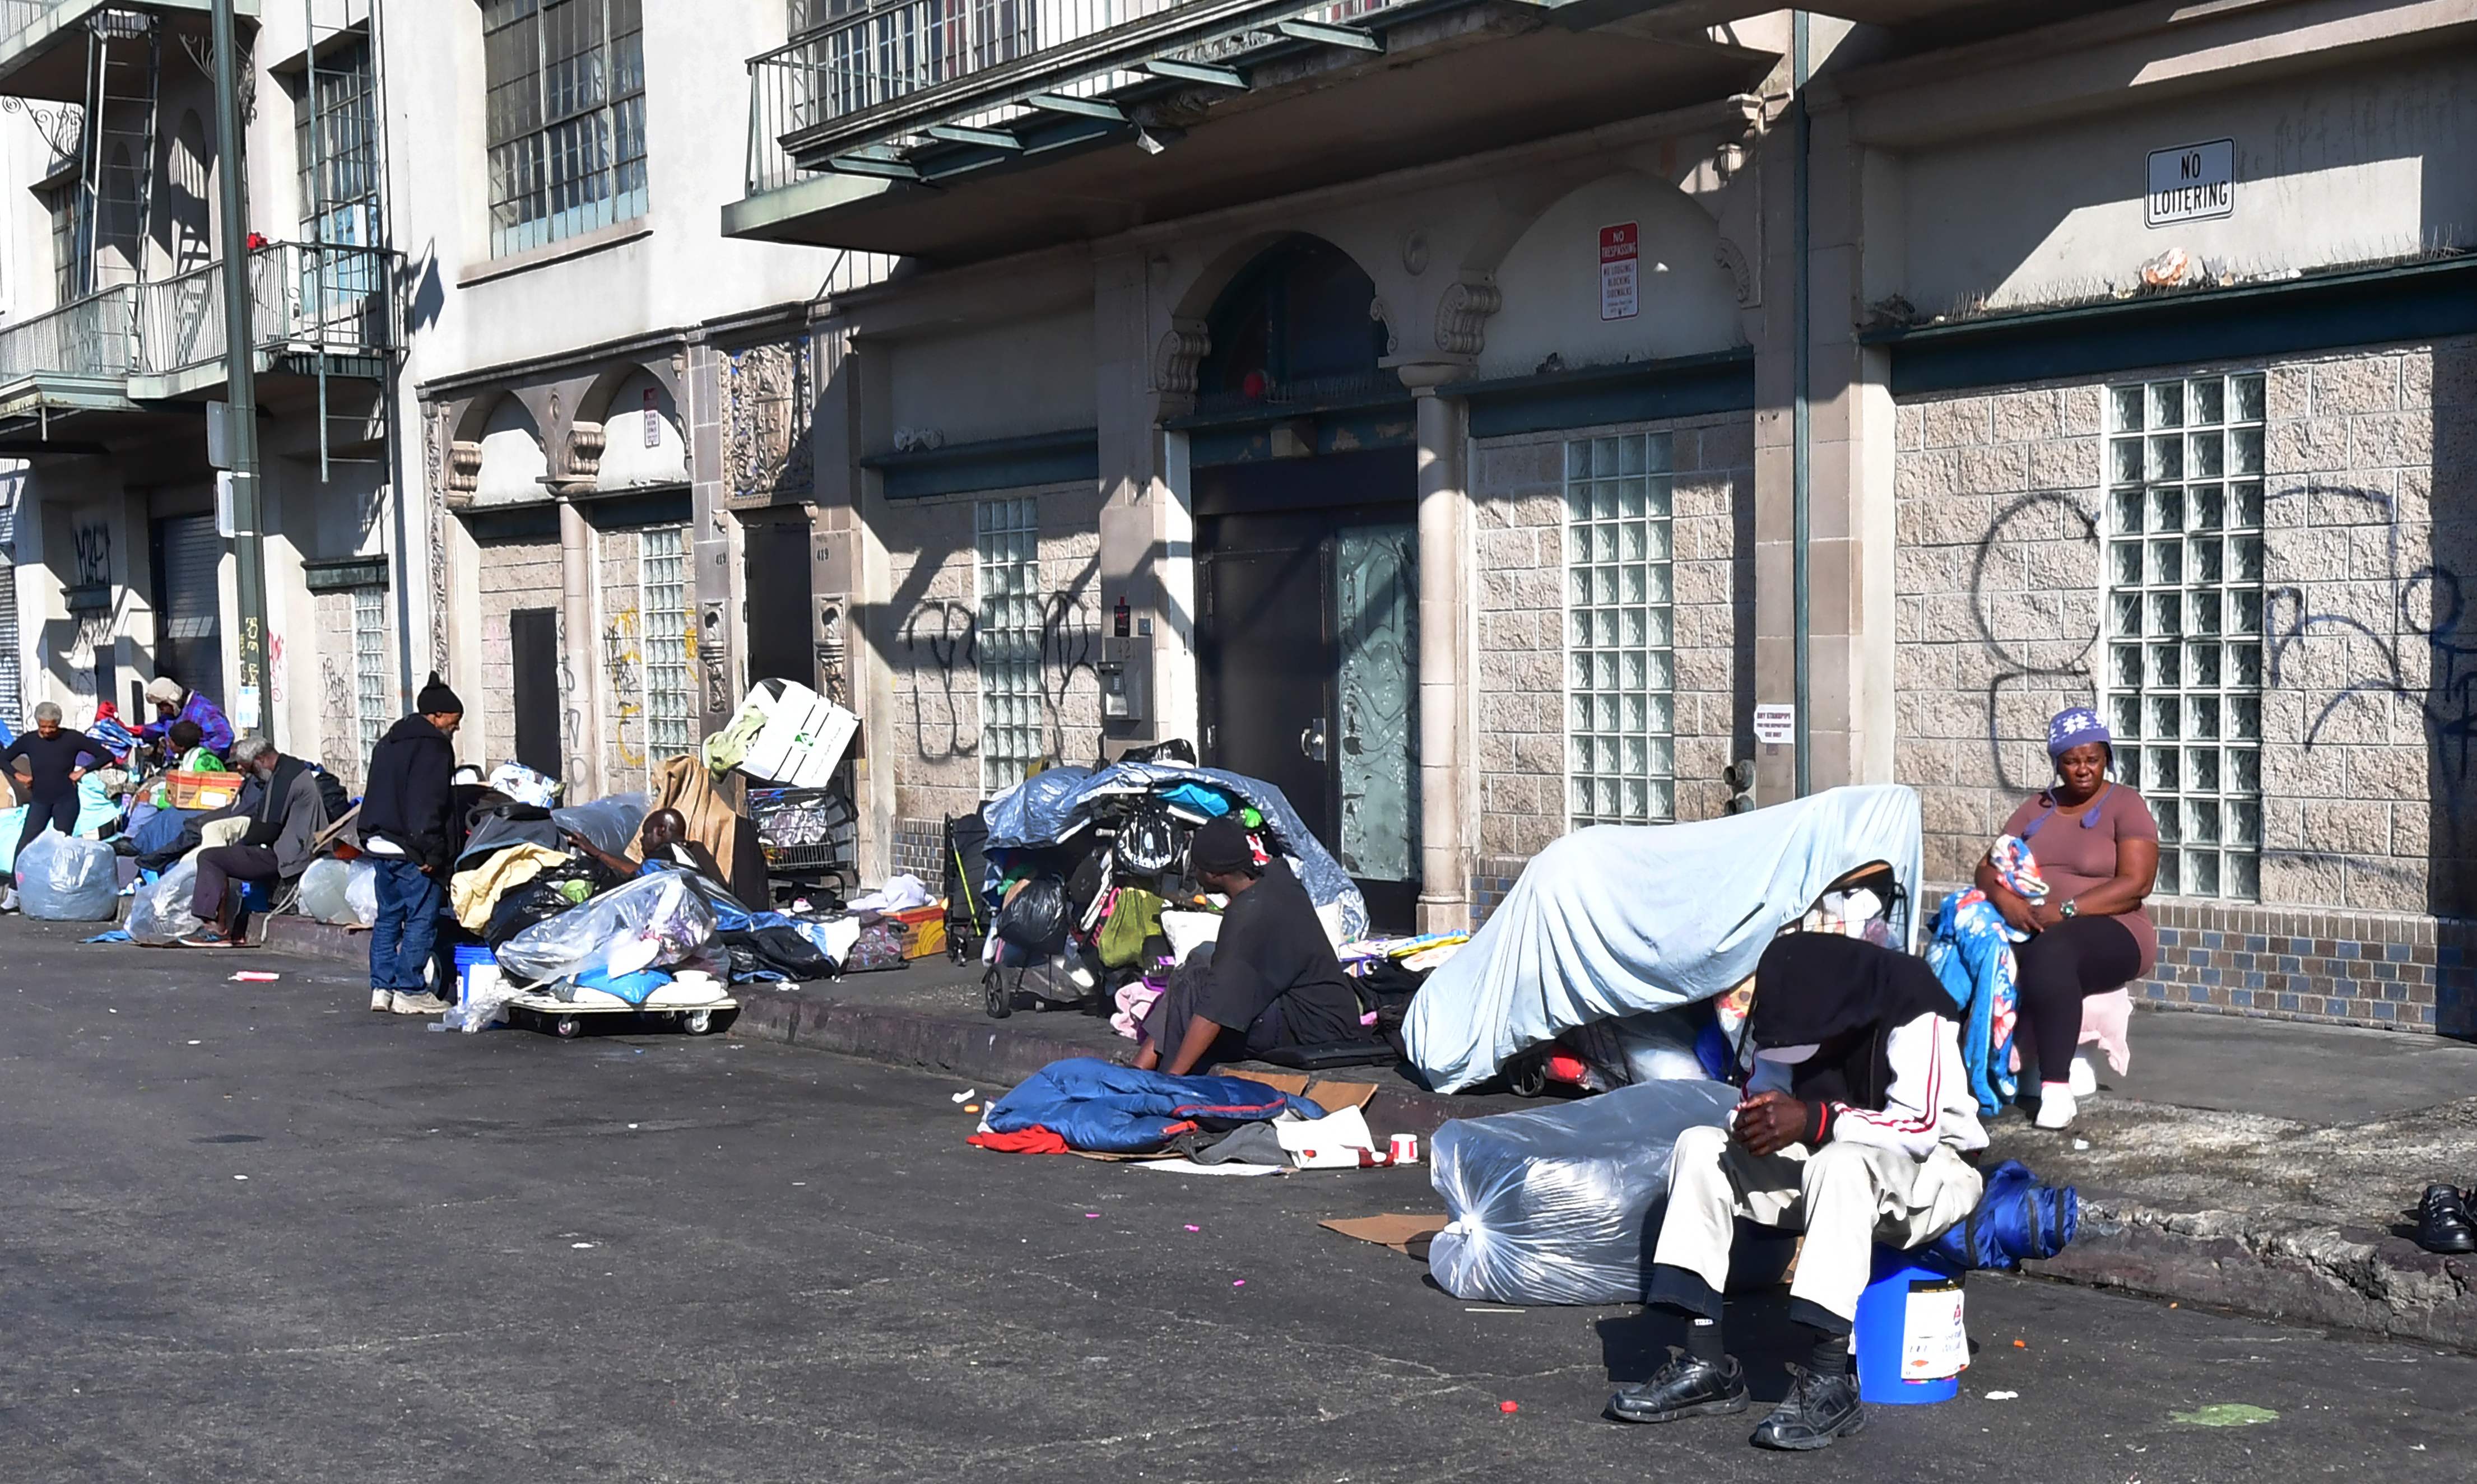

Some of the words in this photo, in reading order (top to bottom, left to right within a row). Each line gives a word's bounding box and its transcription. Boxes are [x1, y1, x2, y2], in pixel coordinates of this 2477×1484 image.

[2181, 153, 2201, 180] NO
[2154, 180, 2228, 215] LOITERING
[1613, 230, 1624, 243] NO
[1602, 242, 1636, 258] TRESPASSING
[715, 552, 727, 566] 419
[816, 547, 829, 562] 419
